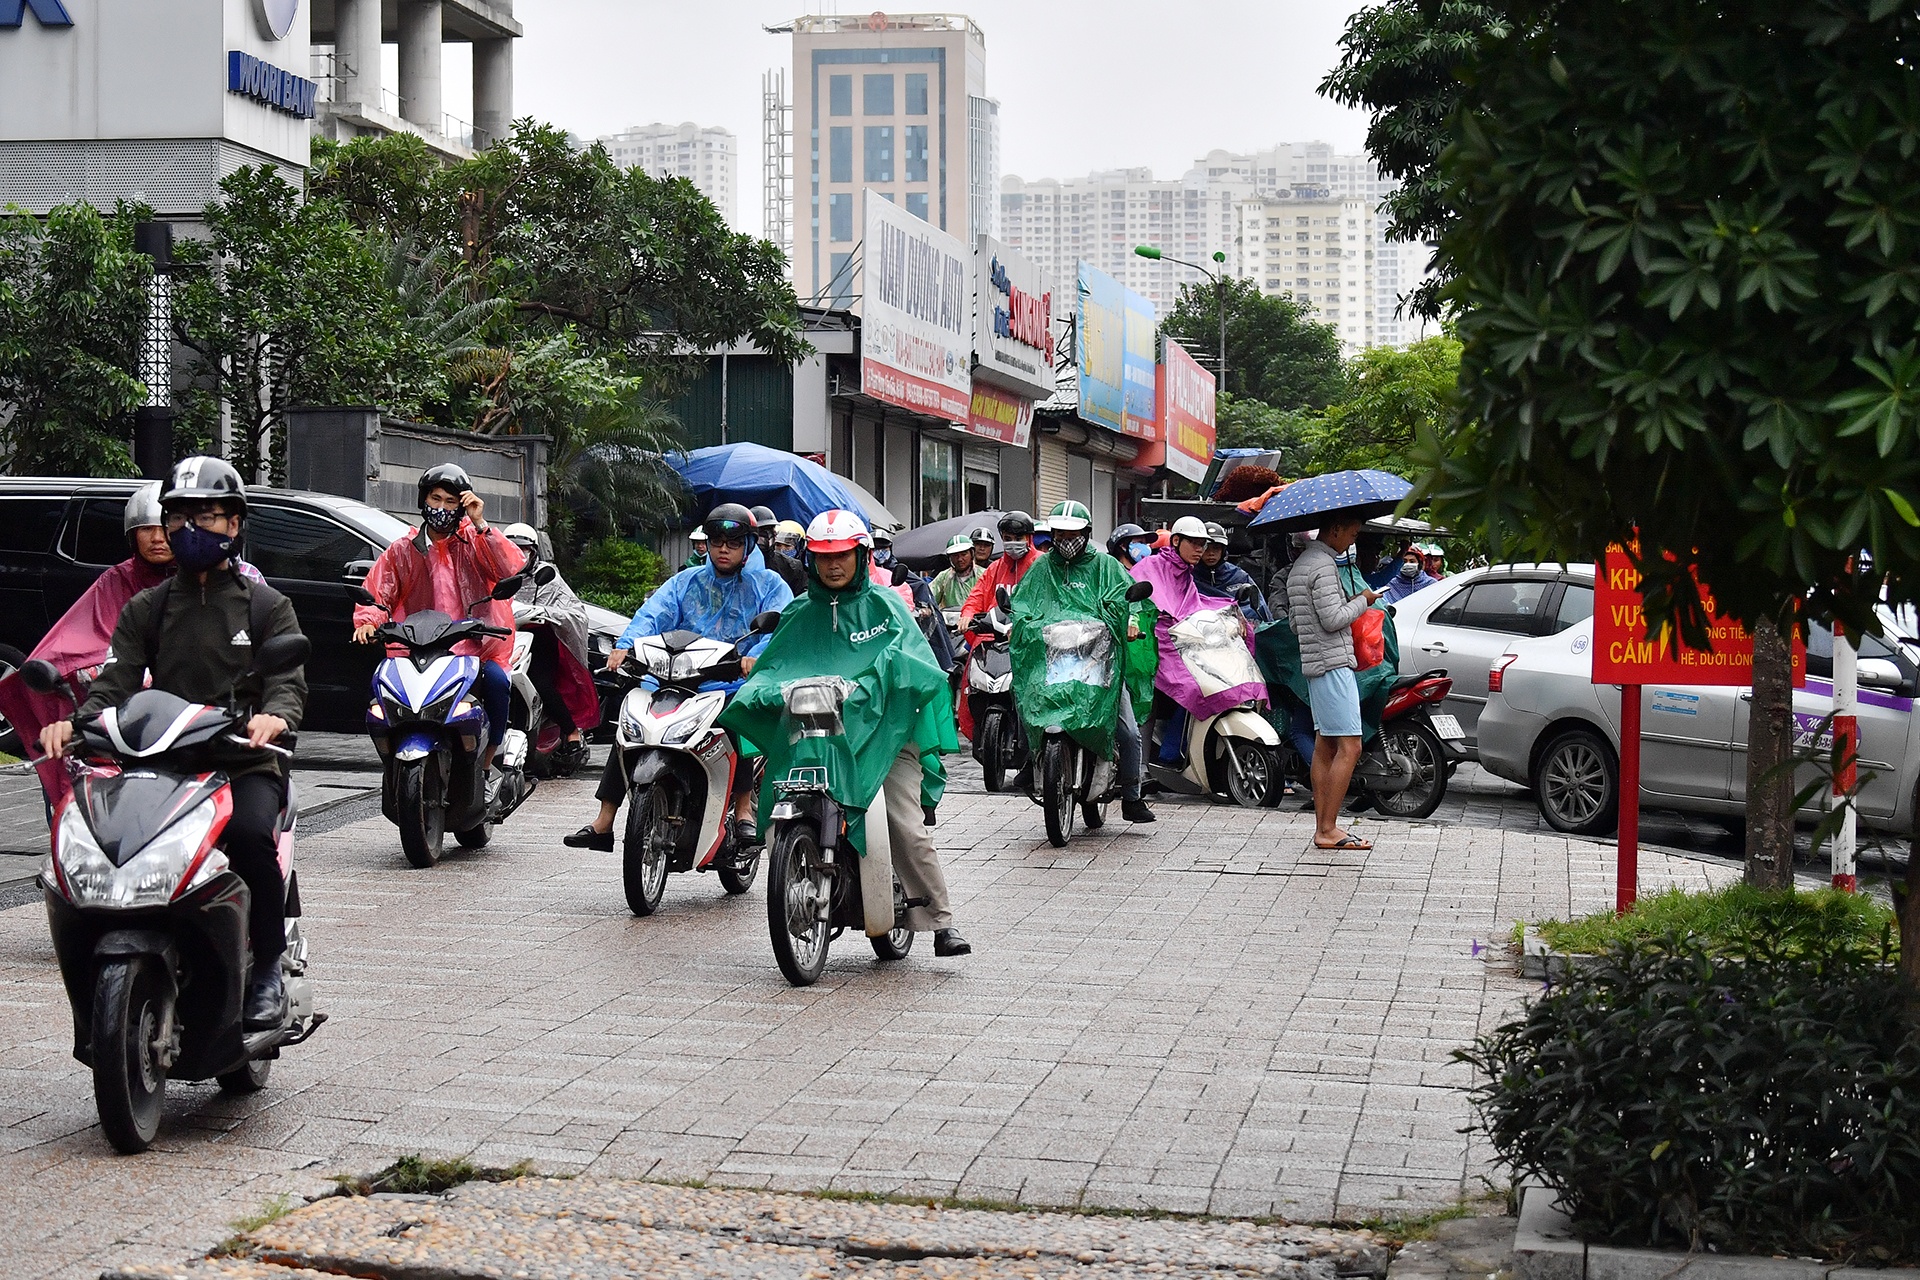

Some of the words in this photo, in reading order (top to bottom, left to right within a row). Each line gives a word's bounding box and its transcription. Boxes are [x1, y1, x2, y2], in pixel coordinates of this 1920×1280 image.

[233, 51, 281, 106] WOORI
[283, 71, 318, 119] BANK
[879, 219, 906, 311] NAM
[940, 253, 964, 336] AUTO
[1730, 624, 1752, 641] TIỆ
[1609, 636, 1653, 664] CẤM
[1700, 650, 1727, 666] DƯỚI
